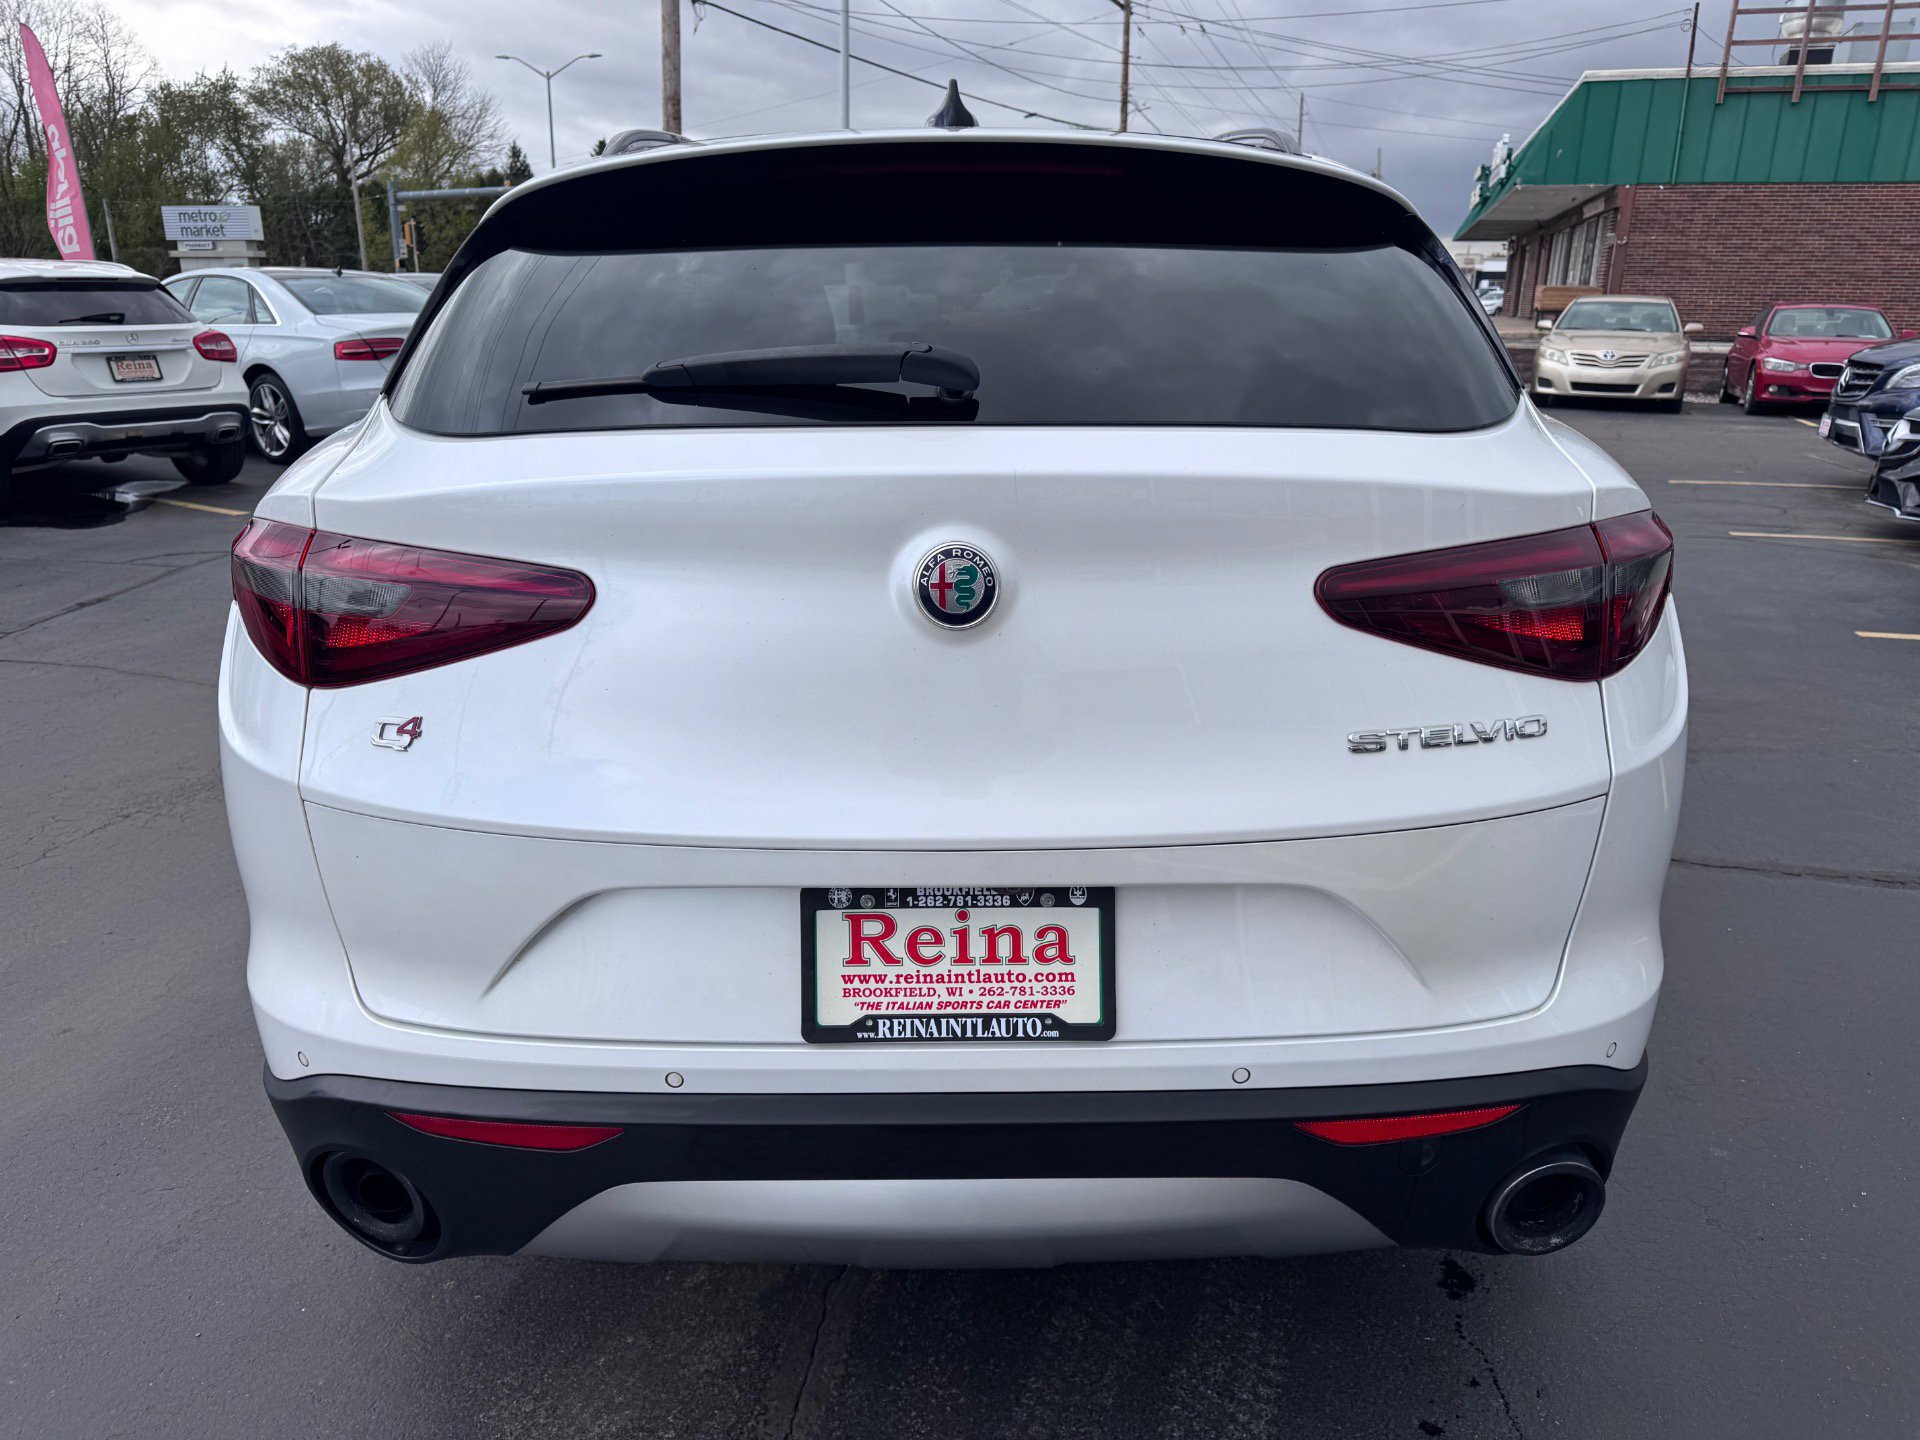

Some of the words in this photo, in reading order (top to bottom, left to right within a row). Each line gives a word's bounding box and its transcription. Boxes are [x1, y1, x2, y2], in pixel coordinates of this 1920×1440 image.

[178, 209, 218, 223] metro
[181, 224, 226, 237] market
[115, 361, 154, 371] Reina
[920, 553, 946, 587] ALFA
[952, 548, 994, 587] ROMEO
[370, 715, 423, 752] Q4
[1347, 714, 1548, 753] STELVIO
[906, 895, 1011, 907] 1-262-781-3336
[841, 908, 1076, 967] Reina
[841, 969, 1076, 986] www.reinaintlauto.com
[842, 987, 941, 999] BROOKFIELD,
[945, 987, 964, 997] WI
[978, 985, 1076, 997] 262-781-3336
[884, 1000, 933, 1011] ITALIAN
[936, 1000, 984, 1011] SPORTS
[986, 999, 1010, 1010] CAR
